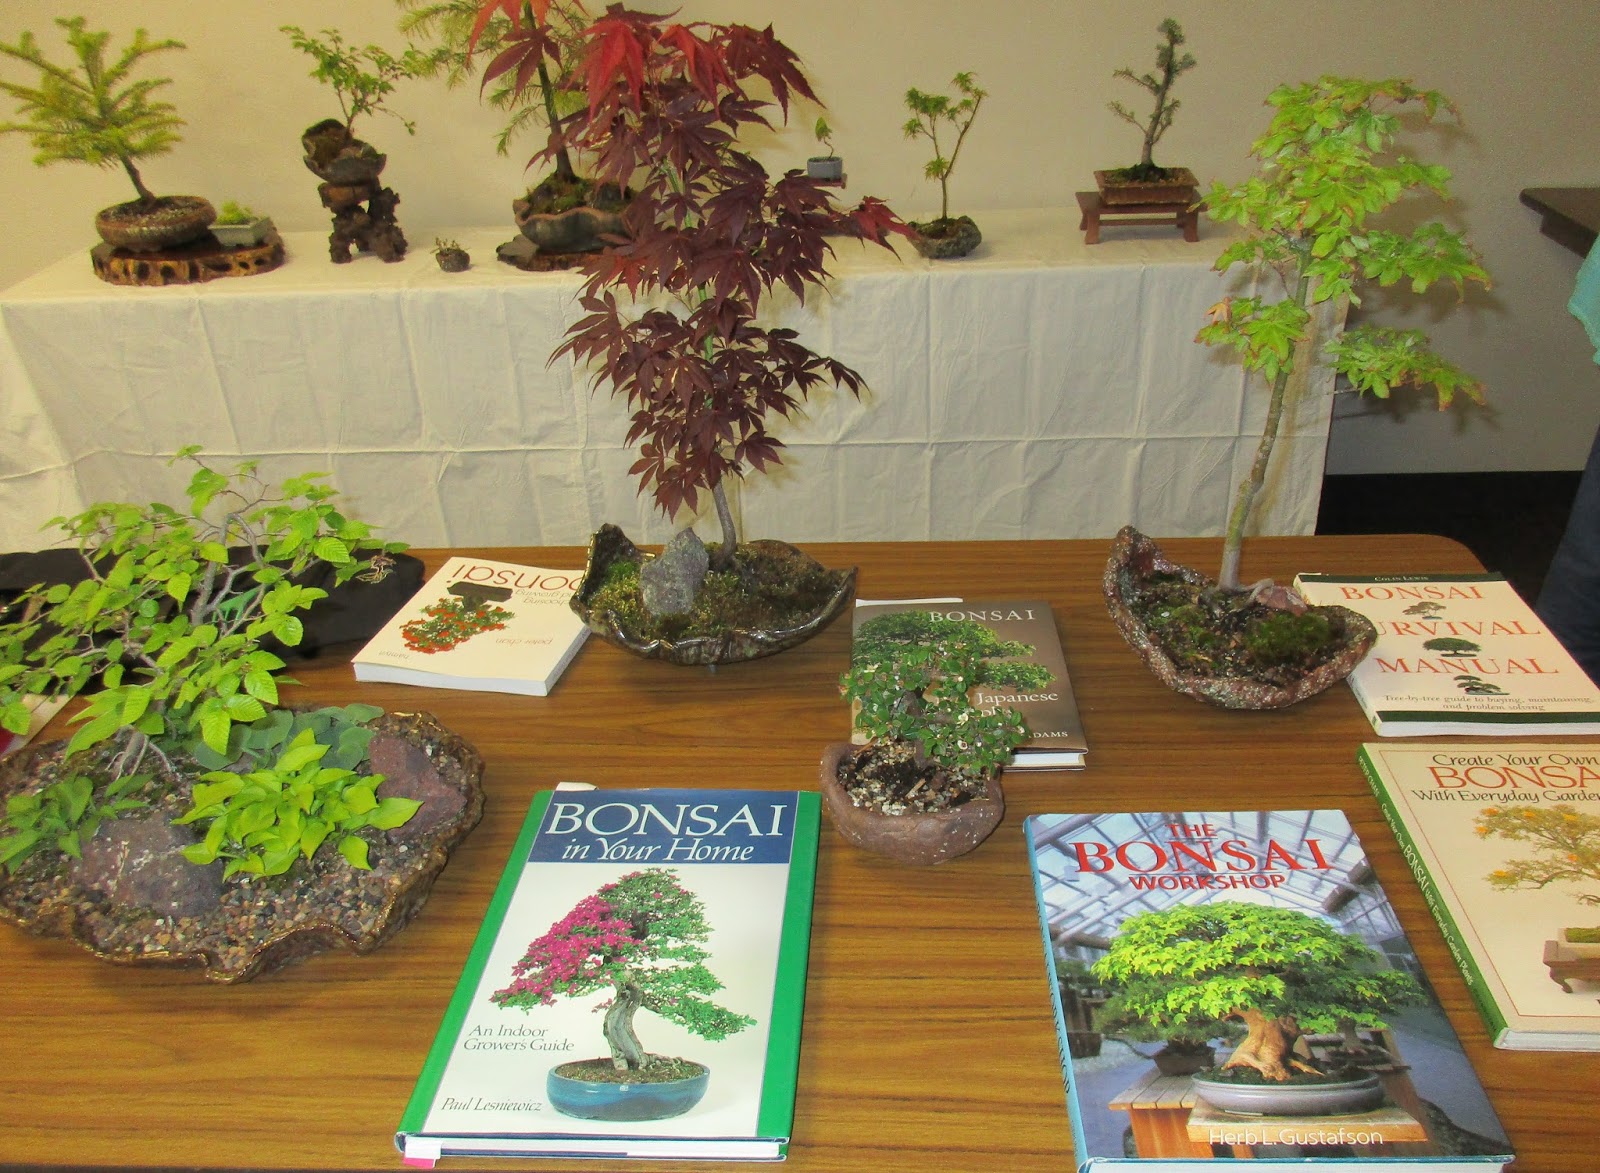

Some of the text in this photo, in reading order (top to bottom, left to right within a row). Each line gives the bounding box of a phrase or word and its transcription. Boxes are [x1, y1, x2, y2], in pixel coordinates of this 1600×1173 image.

[1340, 586, 1487, 600] BONSAI
[929, 609, 1036, 623] BONSAI
[1376, 620, 1541, 636] RVIVAL
[1374, 657, 1560, 674] MANUAL
[976, 692, 1059, 706] Japanese
[1444, 695, 1469, 704] guide
[1474, 695, 1485, 703] to
[1466, 703, 1506, 711] problem
[1508, 703, 1546, 711] solving
[1432, 753, 1600, 766] Create Your Own
[1426, 765, 1600, 789] BONSA
[1411, 789, 1600, 804] With Everyday Garde
[545, 802, 788, 837] BONSAI
[1164, 823, 1218, 838] THE
[561, 837, 755, 861] in Your Home
[1069, 839, 1336, 873] BONSAI
[1128, 874, 1286, 890] WORKSHOP
[1403, 844, 1429, 890] BONSAI
[1432, 906, 1449, 937] Everyday
[1446, 936, 1462, 961] Garden
[1459, 961, 1474, 985] Plants
[468, 1024, 549, 1037] An Indoor
[463, 1038, 575, 1051] Grower's Guide
[441, 1097, 544, 1112] Paul Lesniewicz
[1208, 1127, 1384, 1146] Herb L. Gustafson
